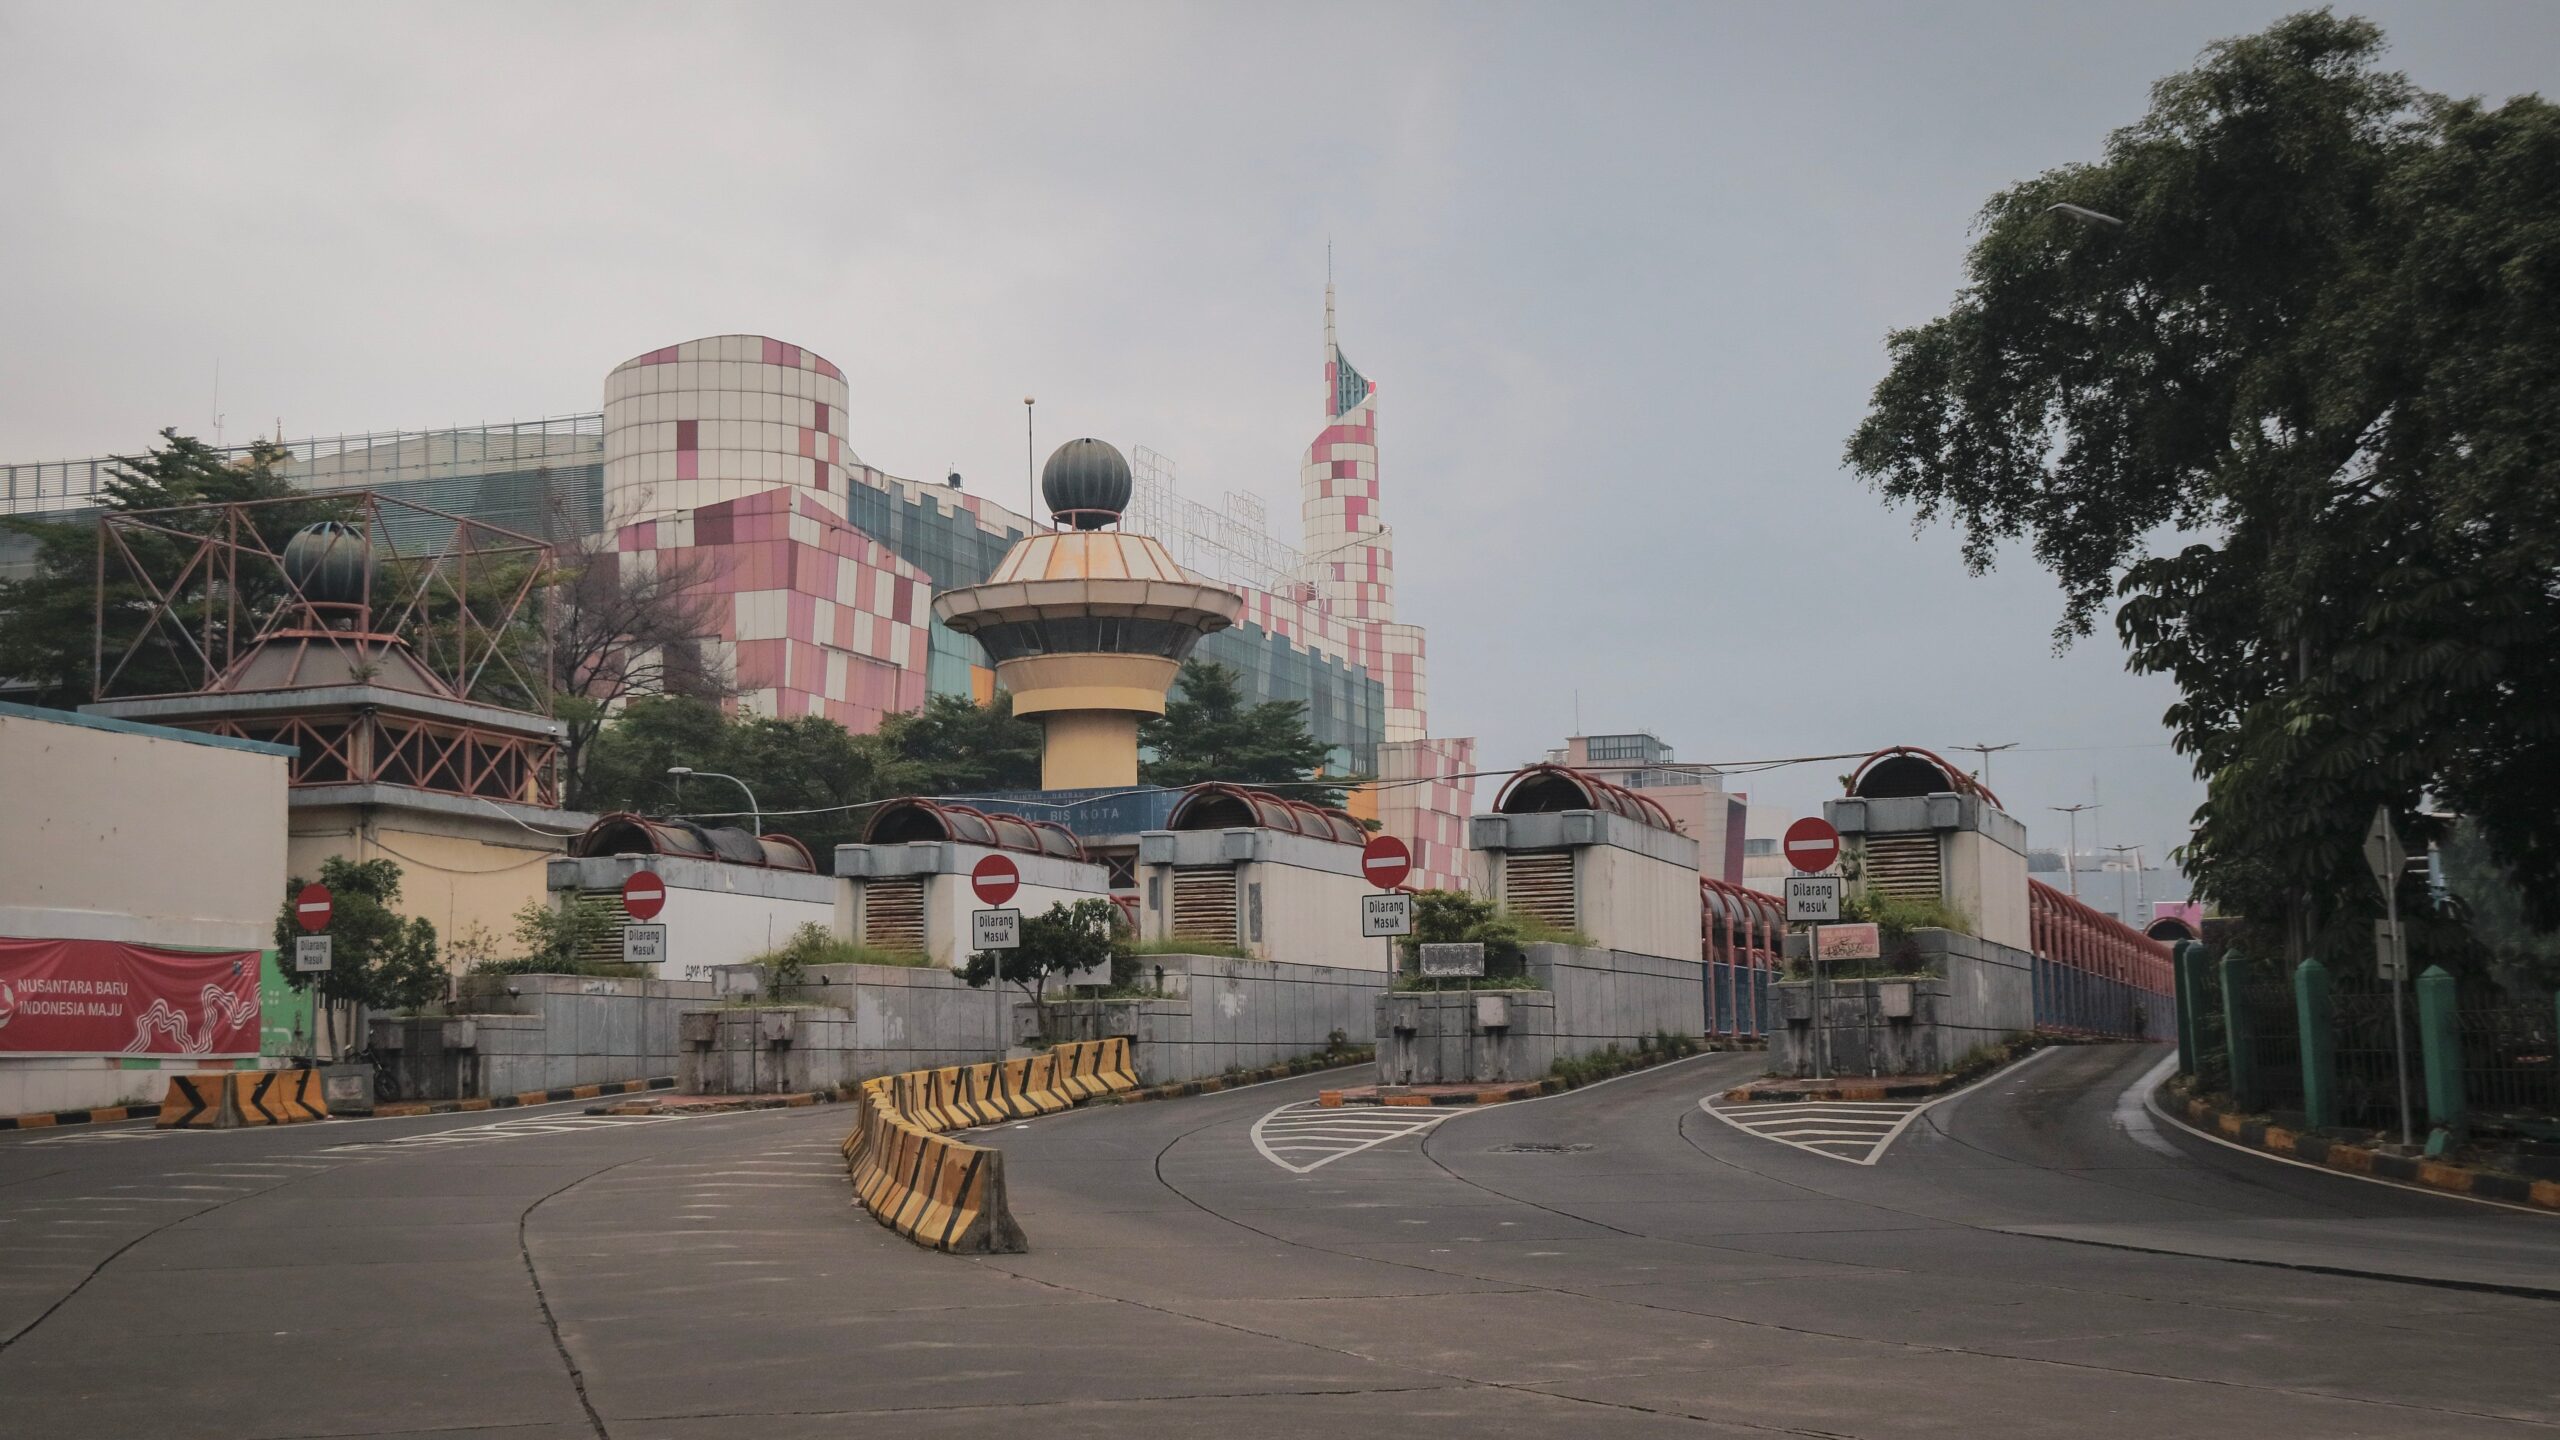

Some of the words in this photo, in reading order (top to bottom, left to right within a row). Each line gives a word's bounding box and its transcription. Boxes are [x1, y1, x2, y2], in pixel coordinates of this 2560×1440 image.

[1050, 809, 1071, 821] BIS
[1080, 808, 1119, 820] KOTA
[1793, 883, 1832, 898] Dilarang
[1369, 900, 1404, 914] Dilarang
[1798, 900, 1827, 912] Masuk
[979, 915, 1013, 928] Dilarang
[1374, 916, 1399, 928] Masuk
[629, 930, 660, 943] Dilarang
[984, 930, 1009, 942] Masuk
[301, 940, 327, 952] Dilarang
[632, 944, 655, 955] Masuk
[304, 955, 323, 965] Masuk
[18, 979, 93, 994] NUSANTARA
[19, 1001, 85, 1016] INDONESIA
[88, 1003, 123, 1016] MAJU
